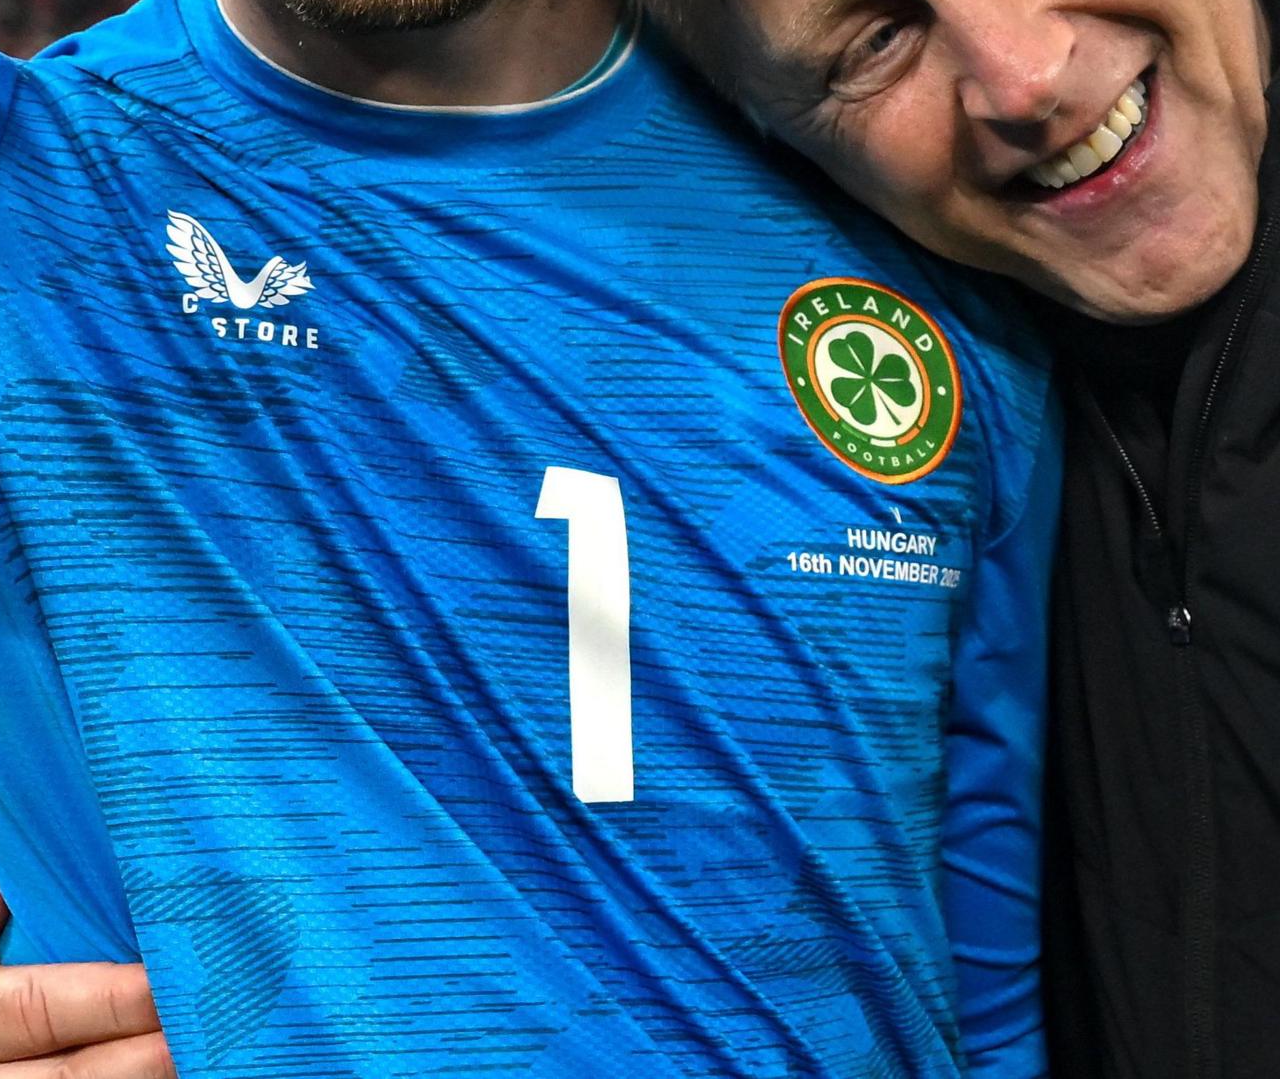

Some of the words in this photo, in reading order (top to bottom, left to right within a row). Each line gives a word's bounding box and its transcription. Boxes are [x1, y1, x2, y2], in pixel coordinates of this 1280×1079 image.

[788, 291, 934, 353] IRELAND
[831, 430, 936, 468] FOOTBALL
[847, 527, 937, 556] HUNGARY
[787, 552, 832, 574] 16th
[839, 555, 938, 584] NOVEMBER
[534, 466, 634, 803] 1
